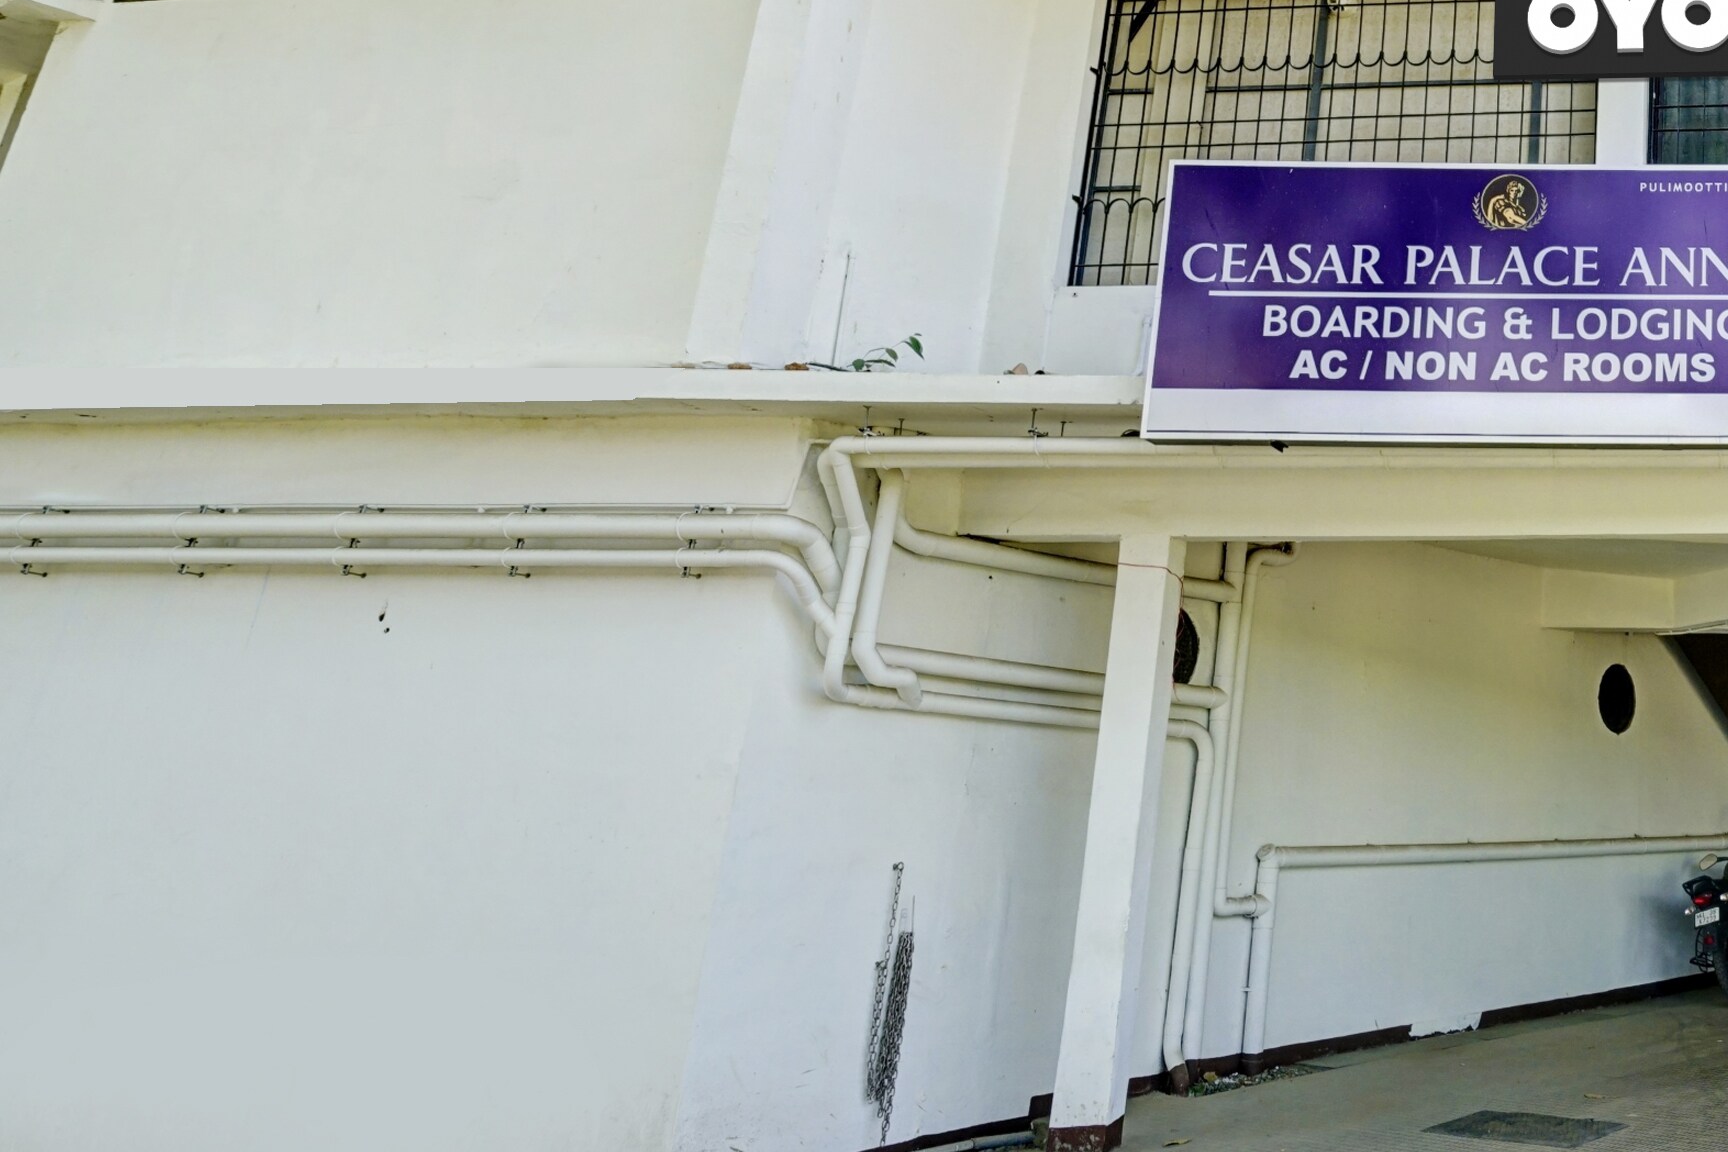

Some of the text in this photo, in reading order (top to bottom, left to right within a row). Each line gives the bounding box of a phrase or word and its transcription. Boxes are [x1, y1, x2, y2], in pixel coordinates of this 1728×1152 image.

[1182, 242, 1384, 284] CEASAR
[1404, 245, 1600, 286] PALACE
[1262, 304, 1487, 340] BOARDING
[1502, 306, 1533, 340] &
[1289, 349, 1348, 380] AC
[1385, 350, 1478, 381] NON
[1489, 351, 1549, 382] AC
[1563, 352, 1717, 383] ROOMS
